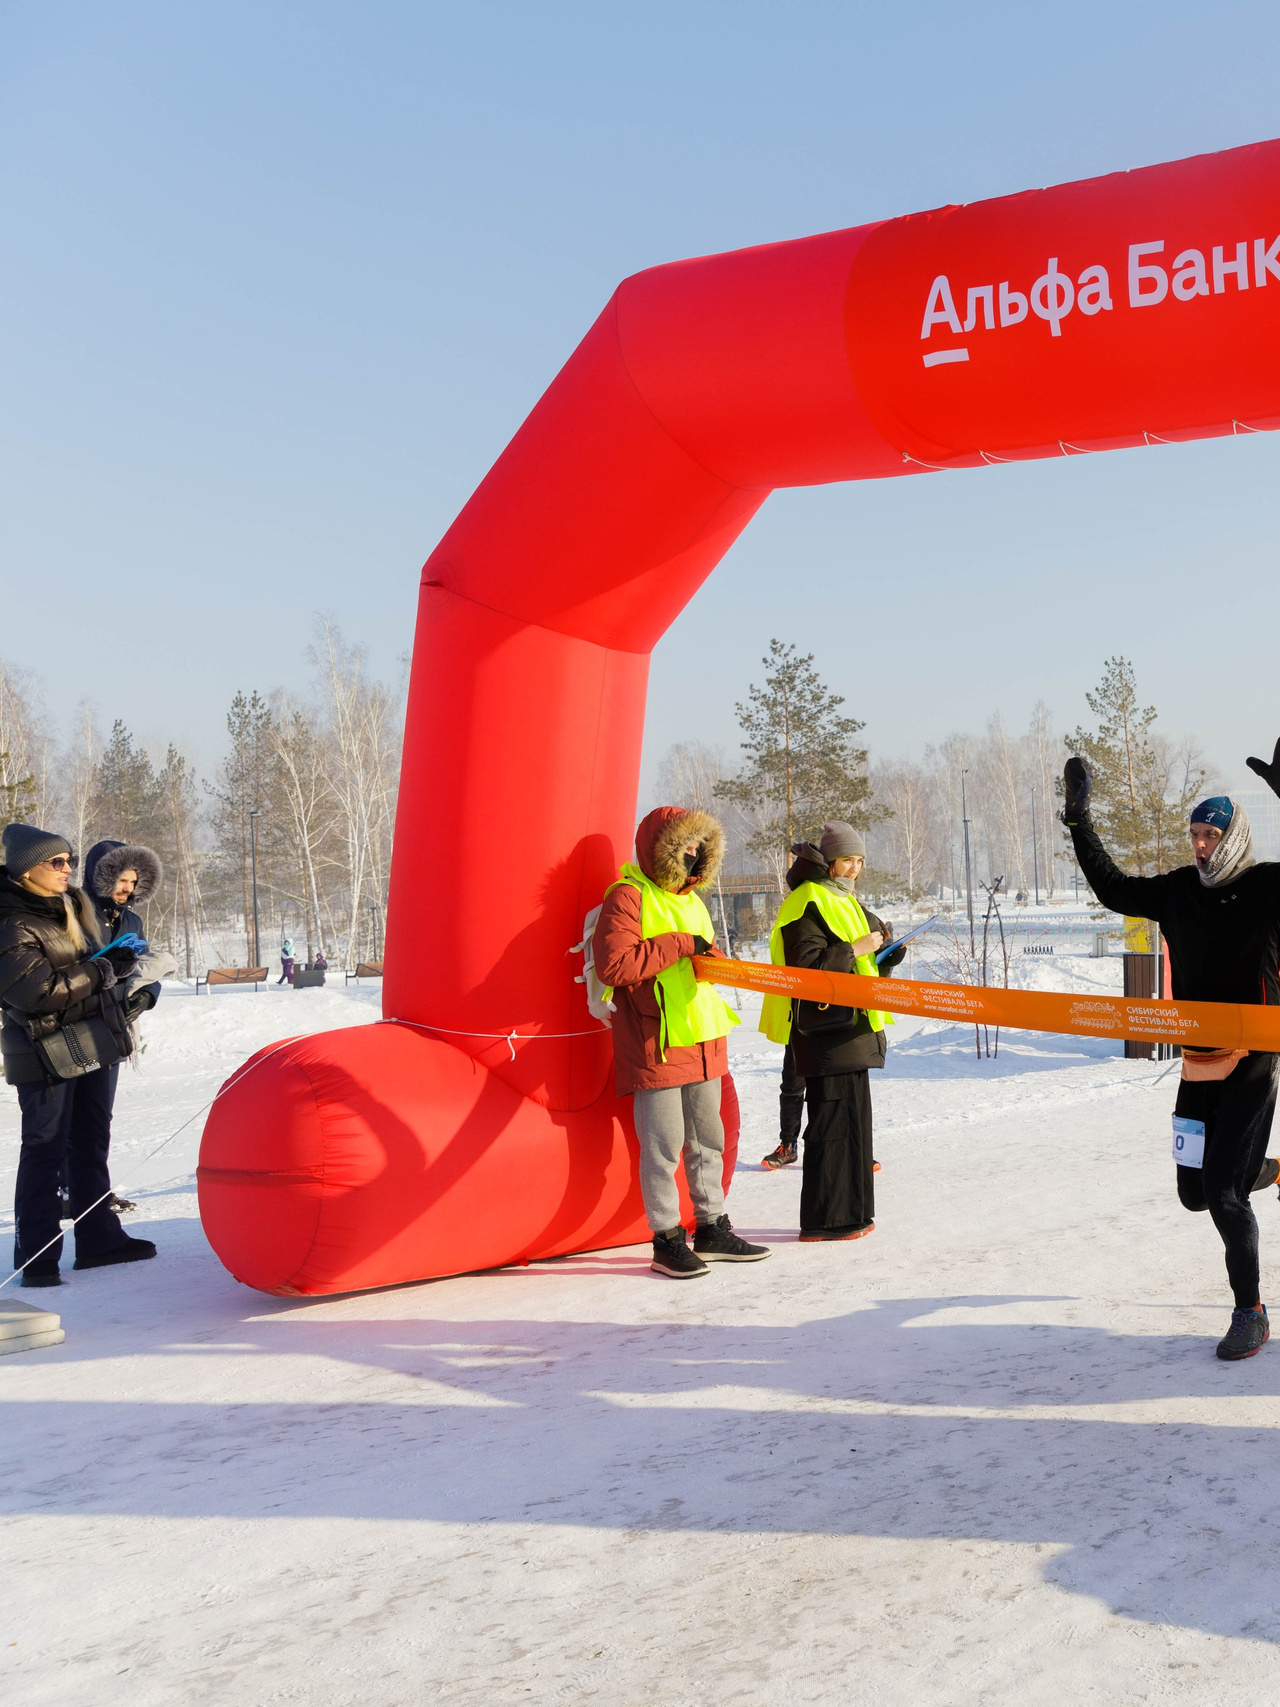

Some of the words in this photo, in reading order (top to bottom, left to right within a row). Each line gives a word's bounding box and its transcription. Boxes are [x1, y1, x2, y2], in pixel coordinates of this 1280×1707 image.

[920, 257, 1113, 340] Альфа
[919, 987, 966, 998] СИБИРСКИЙ
[923, 995, 966, 1006] ФЕСТИВАЛЬ
[966, 1000, 984, 1009] БЕГА
[1126, 1006, 1179, 1017] СИБИРСКИЙ
[1128, 1015, 1178, 1026] ФЕСТИВАЛЬ
[1178, 1019, 1200, 1028] БЕГА
[1128, 1026, 1187, 1036] www.marafon.nsk.ru
